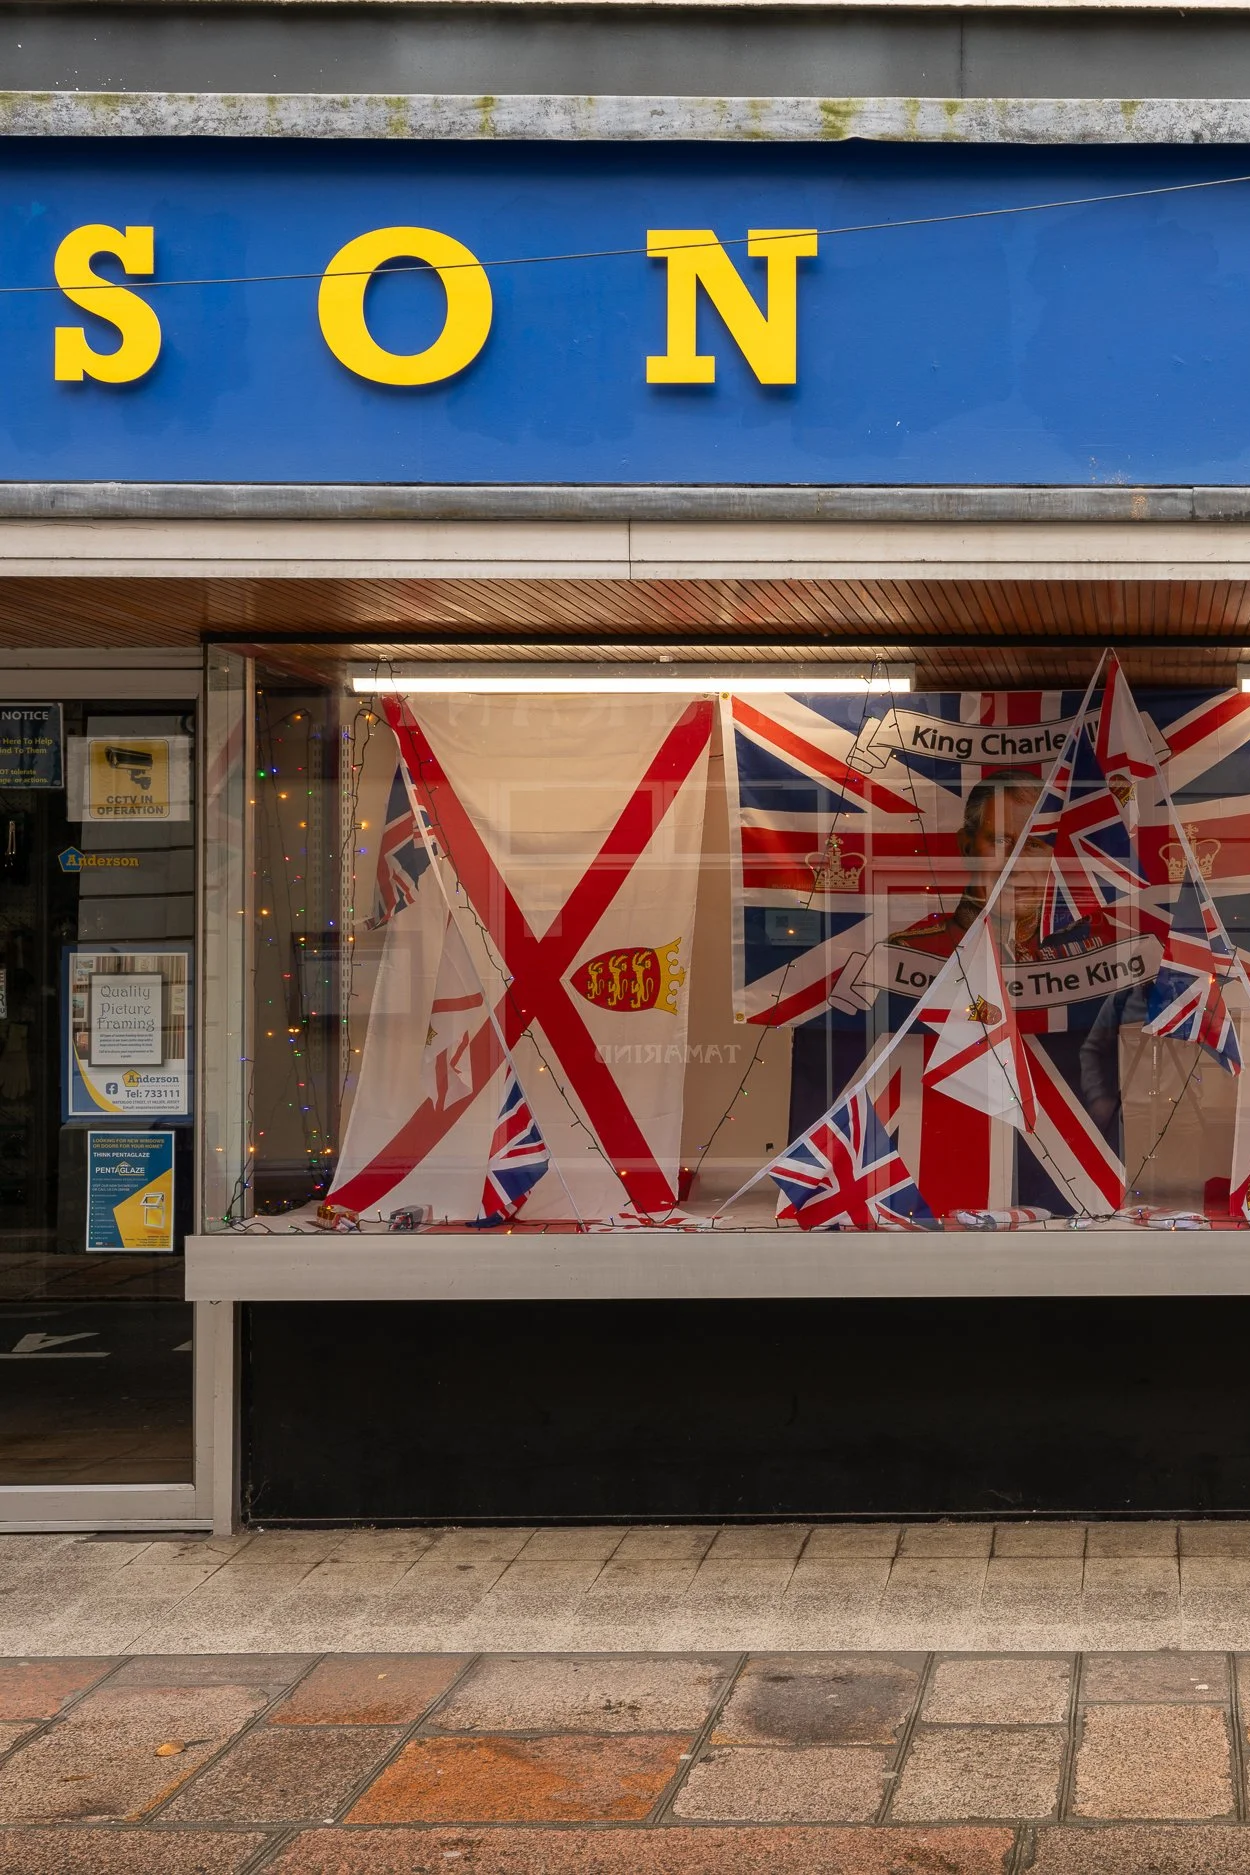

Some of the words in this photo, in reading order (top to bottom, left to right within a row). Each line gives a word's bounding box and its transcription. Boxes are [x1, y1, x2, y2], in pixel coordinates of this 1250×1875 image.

[1, 711, 49, 721] NOTICE
[35, 738, 53, 747] Help
[912, 725, 973, 759] King
[981, 729, 1067, 756] Charle
[106, 795, 137, 804] CCTV
[140, 795, 153, 804] IN
[97, 805, 164, 815] OPERATION
[65, 854, 140, 867] Anderson
[1027, 972, 1080, 996] The
[1085, 954, 1147, 987] King
[100, 985, 151, 1000] Quality
[100, 1002, 152, 1017] Picture
[96, 1017, 155, 1032] Framing
[128, 1075, 180, 1083] Anderson
[125, 1089, 143, 1098] Tel:
[144, 1089, 180, 1098] 733111
[95, 1166, 146, 1174] PENTAGLAZE
